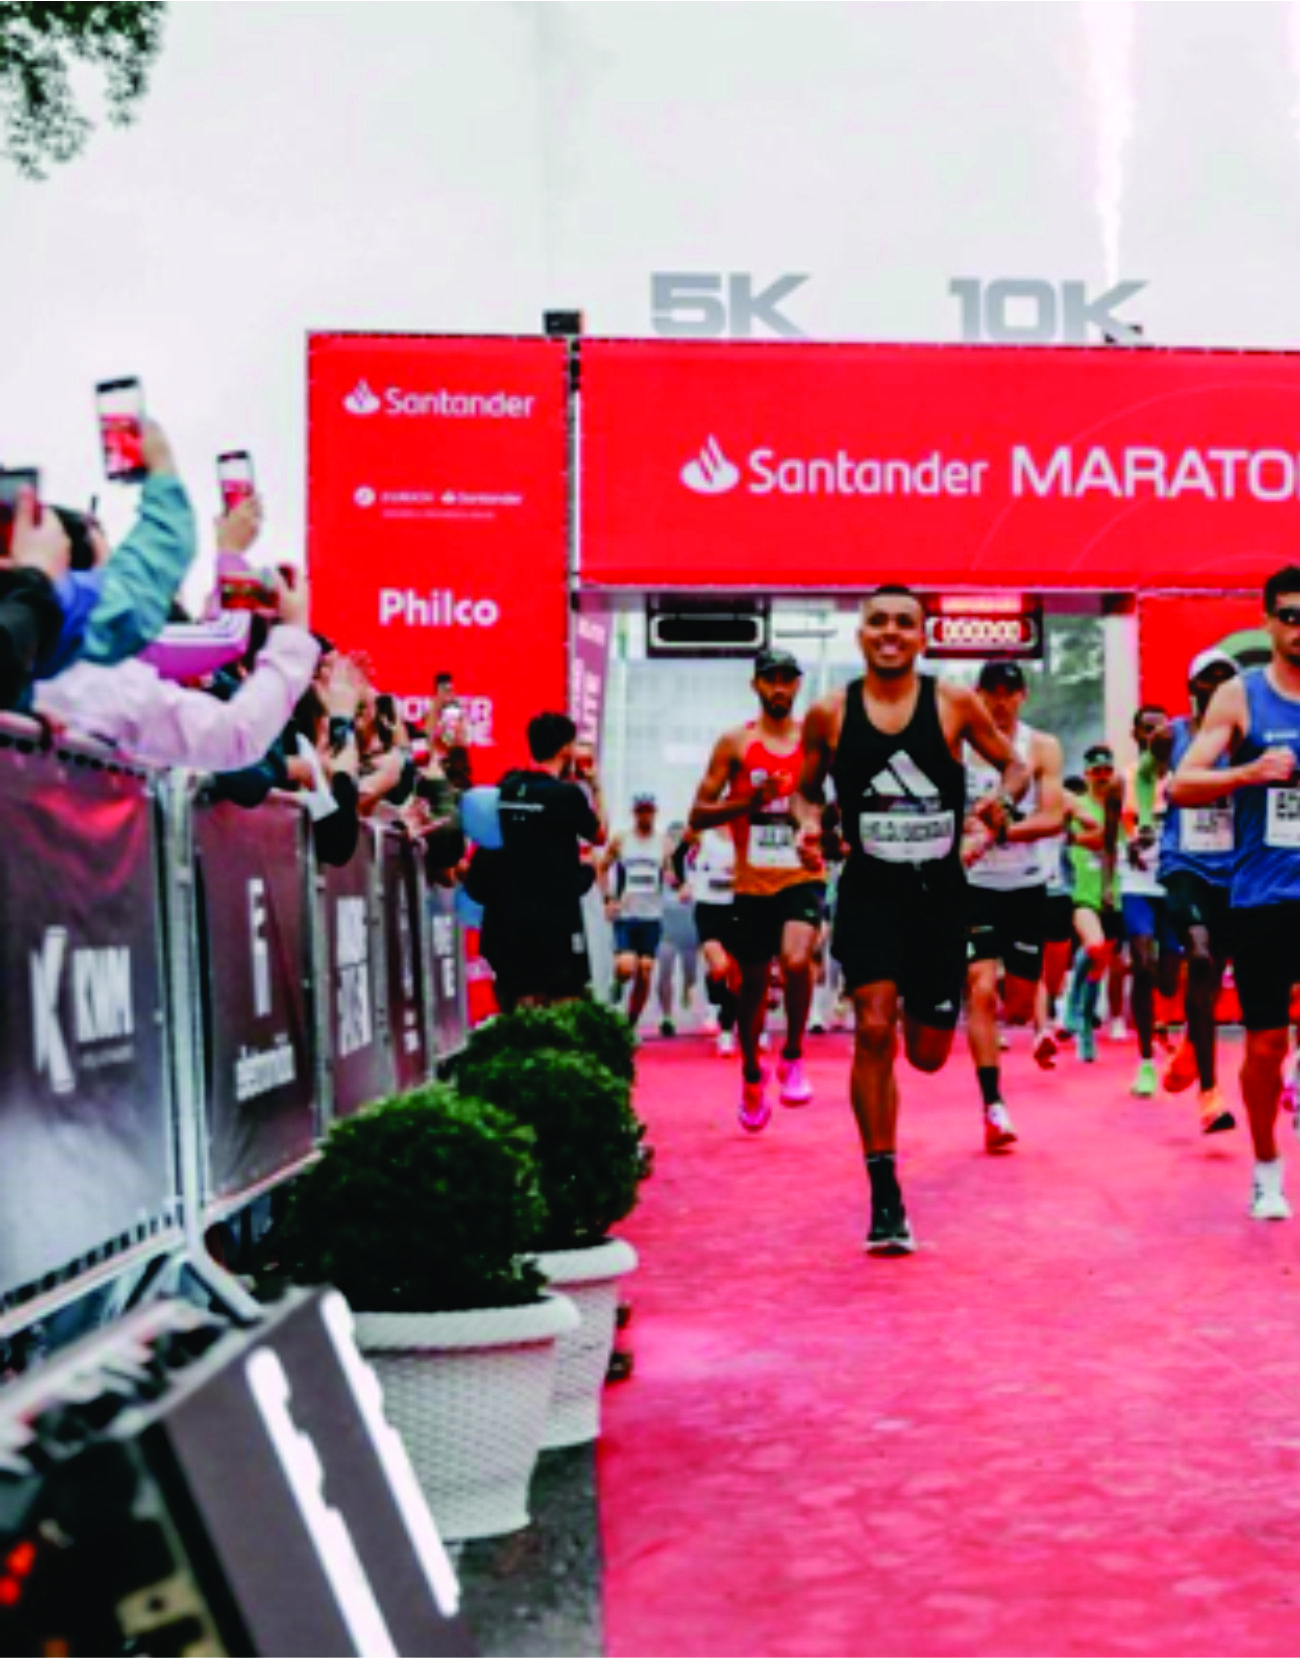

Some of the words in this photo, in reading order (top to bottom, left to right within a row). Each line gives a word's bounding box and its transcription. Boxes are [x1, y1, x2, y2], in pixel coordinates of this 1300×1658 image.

[651, 272, 811, 338] 5K
[949, 278, 1149, 343] 10K
[384, 386, 535, 418] Santander
[747, 446, 989, 496] Santander
[378, 587, 499, 628] Philco
